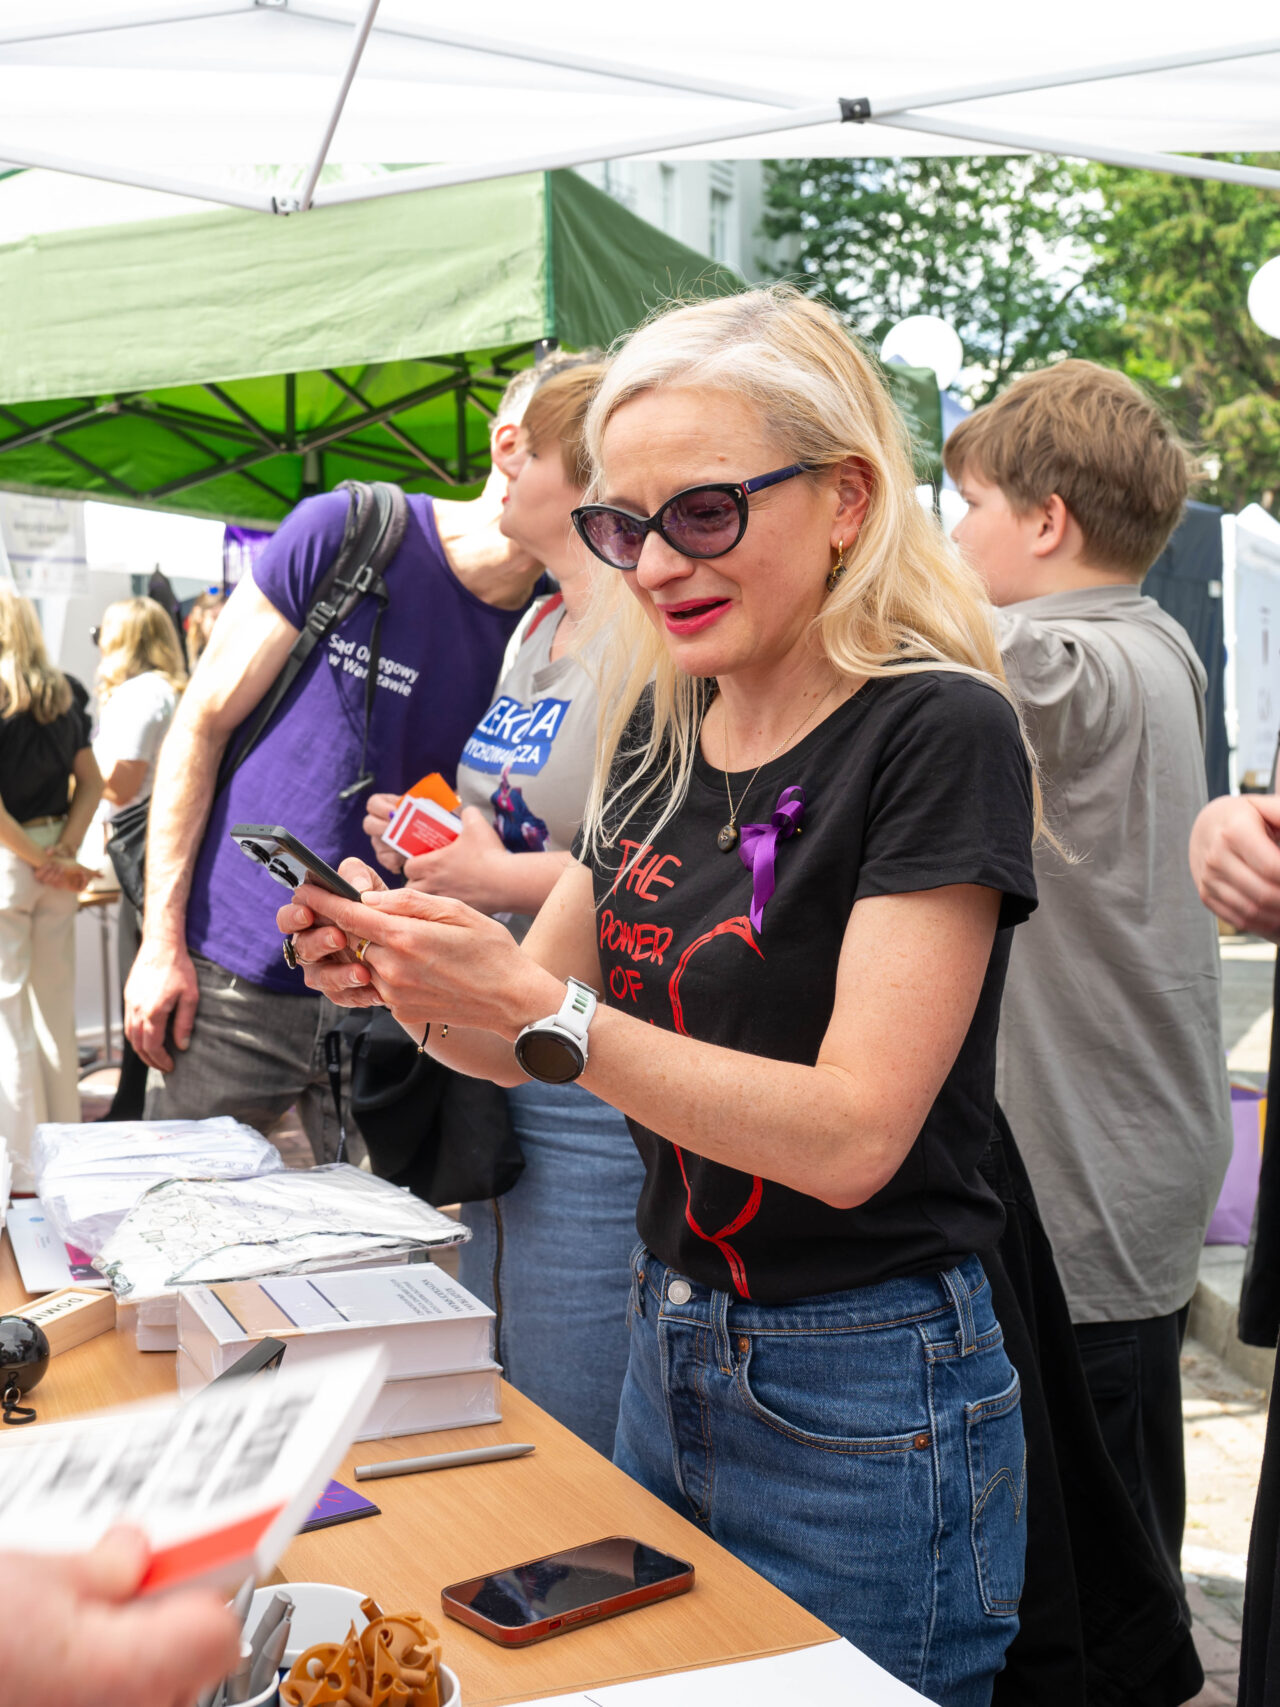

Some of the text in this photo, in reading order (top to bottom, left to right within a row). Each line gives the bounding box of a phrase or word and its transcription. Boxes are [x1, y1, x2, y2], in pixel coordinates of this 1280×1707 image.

[328, 633, 420, 685] Sąd Oęgowy
[328, 653, 412, 697] w Warzawie
[612, 838, 683, 903] THE
[600, 909, 674, 966] POWER
[609, 965, 644, 1003] OF
[31, 1297, 85, 1323] DOMIN
